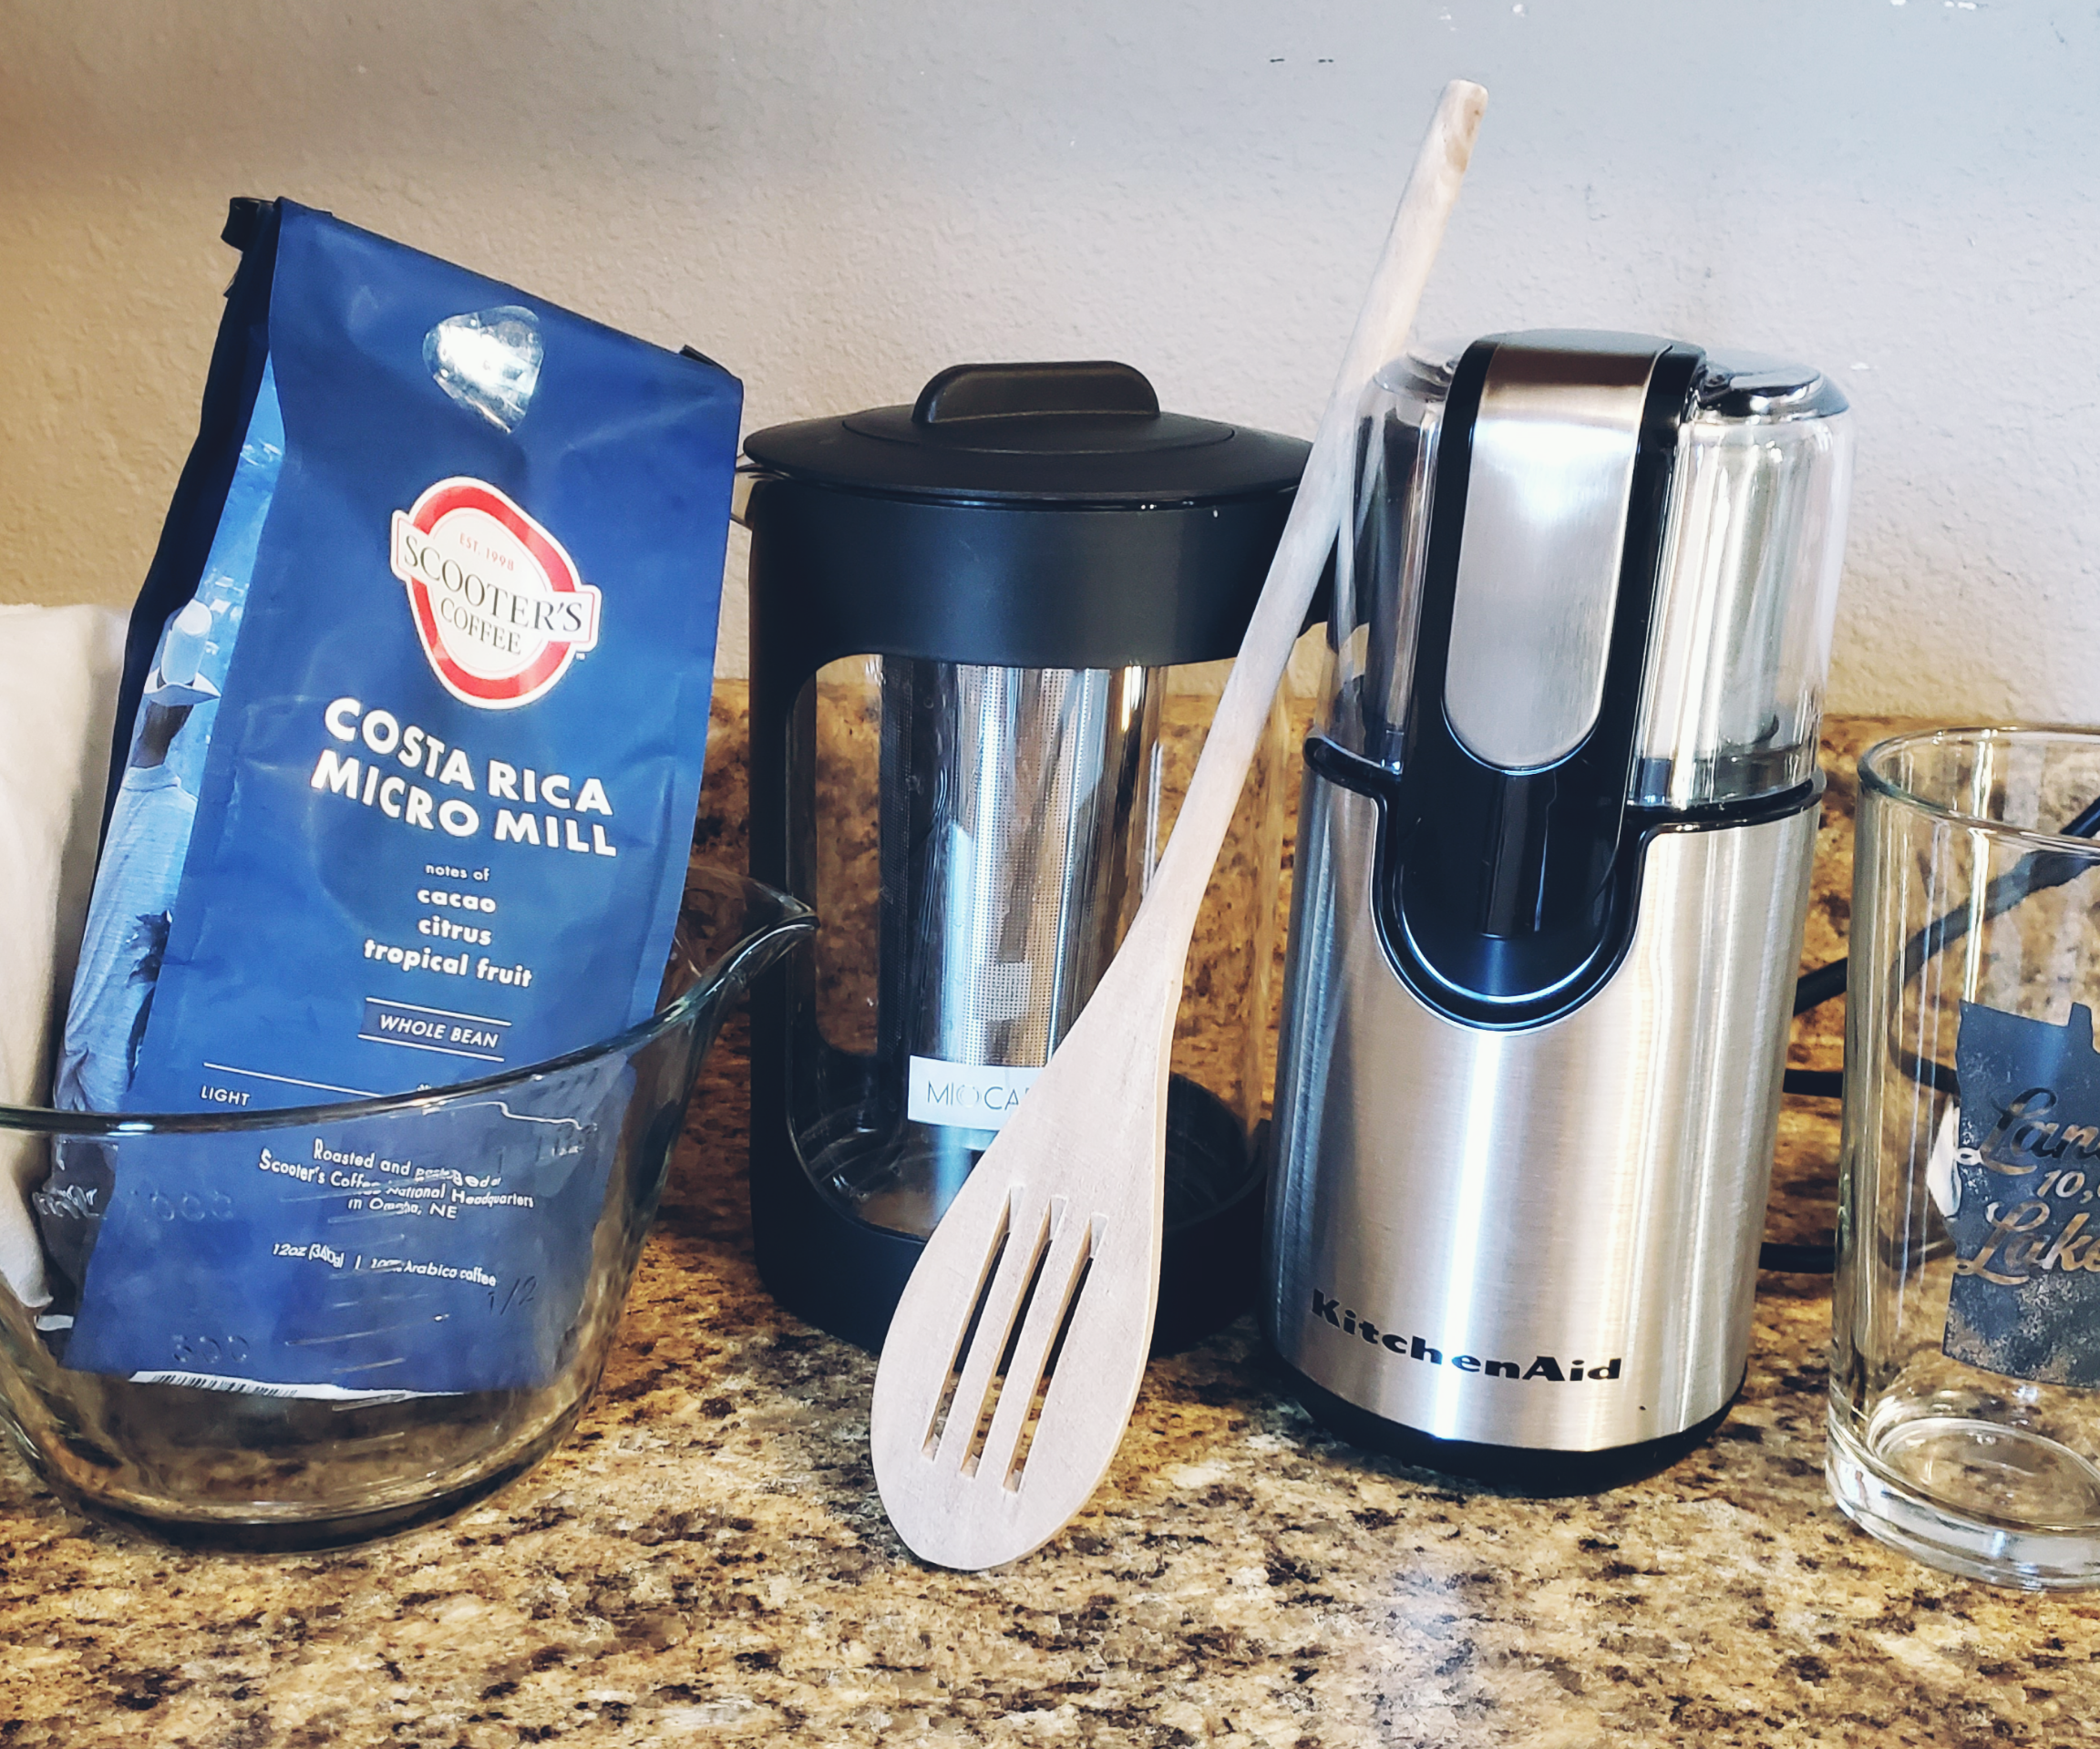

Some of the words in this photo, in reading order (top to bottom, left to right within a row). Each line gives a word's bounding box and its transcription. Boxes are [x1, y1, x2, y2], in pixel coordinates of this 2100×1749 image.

[459, 532, 481, 555] EST.
[486, 548, 514, 571] 1998
[405, 534, 582, 633] SCOOTER'S
[440, 597, 521, 655] COFFEE
[324, 696, 476, 791] COSTA
[488, 759, 613, 816] RICA
[311, 749, 479, 838] MICRO
[494, 808, 617, 858] MILL
[426, 862, 468, 880] notes
[472, 867, 490, 882] of
[417, 889, 497, 913] cacao
[417, 915, 493, 946] citrus
[363, 938, 468, 976] tropical
[476, 960, 533, 989] fruit
[379, 1013, 447, 1041] WHOLE
[450, 1026, 499, 1049] BEAN
[201, 1085, 251, 1107] LIGHT
[927, 1080, 1030, 1110] MIOCA
[1954, 1087, 2100, 1176] Lan
[314, 1137, 376, 1169] Roasted
[379, 1159, 412, 1176] and
[259, 1147, 325, 1185] Scooter's
[451, 1188, 534, 1209] Headquarters
[2036, 1169, 2100, 1204] 10,
[348, 1199, 363, 1210] in
[429, 1202, 458, 1219] NE
[273, 1243, 306, 1258] 12oz
[404, 1260, 458, 1279] Arabica
[459, 1267, 497, 1287] coffee
[1312, 1289, 1621, 1382] KitchenAid
